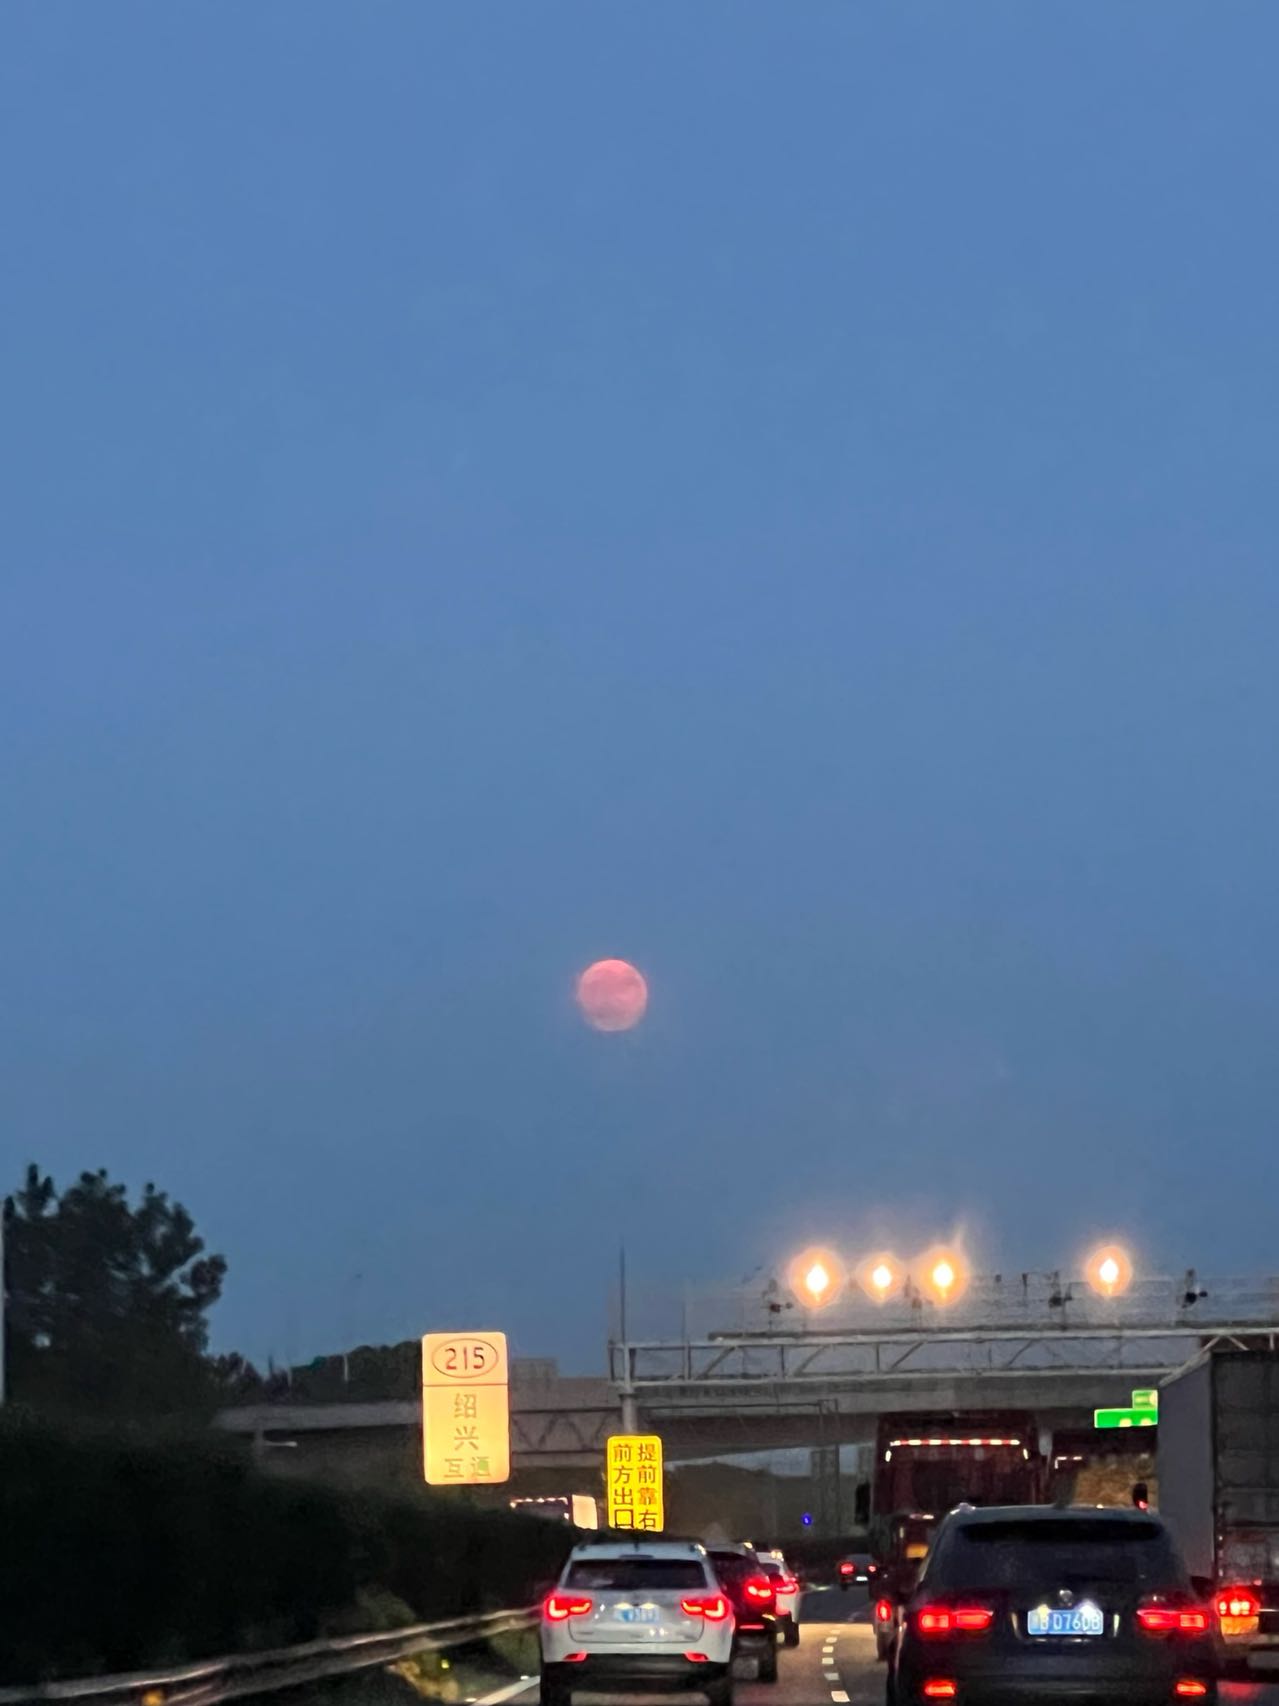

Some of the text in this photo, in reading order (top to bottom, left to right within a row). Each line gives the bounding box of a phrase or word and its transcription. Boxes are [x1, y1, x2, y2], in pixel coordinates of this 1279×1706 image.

[444, 1347, 485, 1370] 215
[454, 1393, 479, 1451] 绍兴
[443, 1456, 491, 1479] 互通
[613, 1444, 634, 1529] 前方出口
[637, 1443, 659, 1529] 提前靠右
